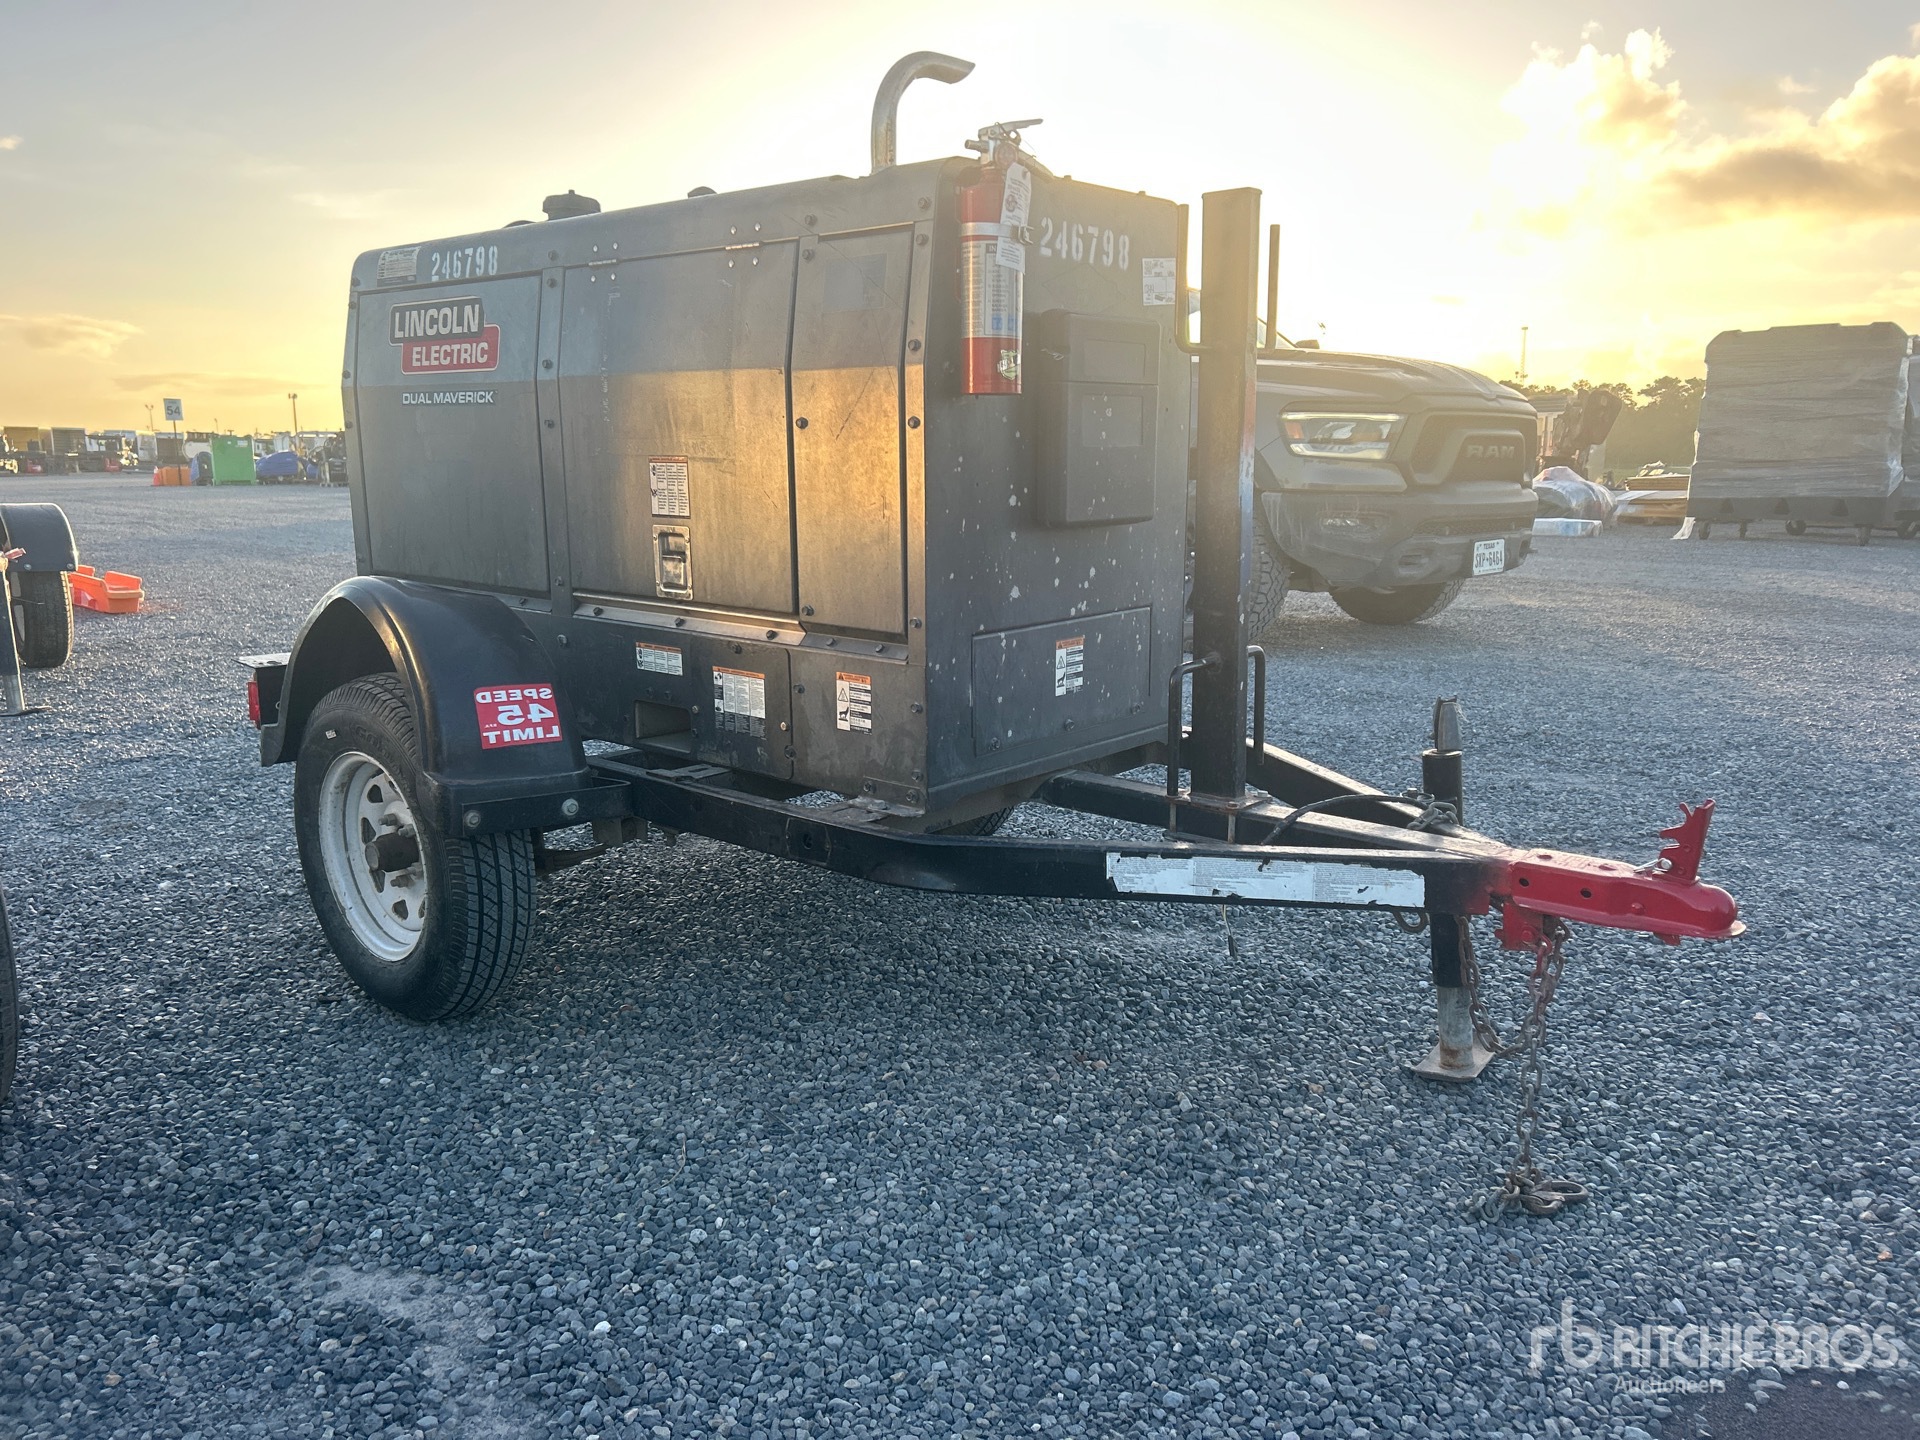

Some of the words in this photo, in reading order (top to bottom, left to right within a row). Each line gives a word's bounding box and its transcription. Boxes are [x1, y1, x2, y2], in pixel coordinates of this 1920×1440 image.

[1039, 216, 1130, 271] 246798
[431, 245, 498, 282] 246798
[394, 304, 479, 338] LINCOLN
[411, 341, 489, 367] ELECTRIC
[402, 393, 431, 404] DUAL
[433, 391, 494, 404] MAVERICK
[166, 405, 181, 416] 54
[1467, 445, 1515, 460] RAM
[1483, 542, 1496, 550] TEXAS
